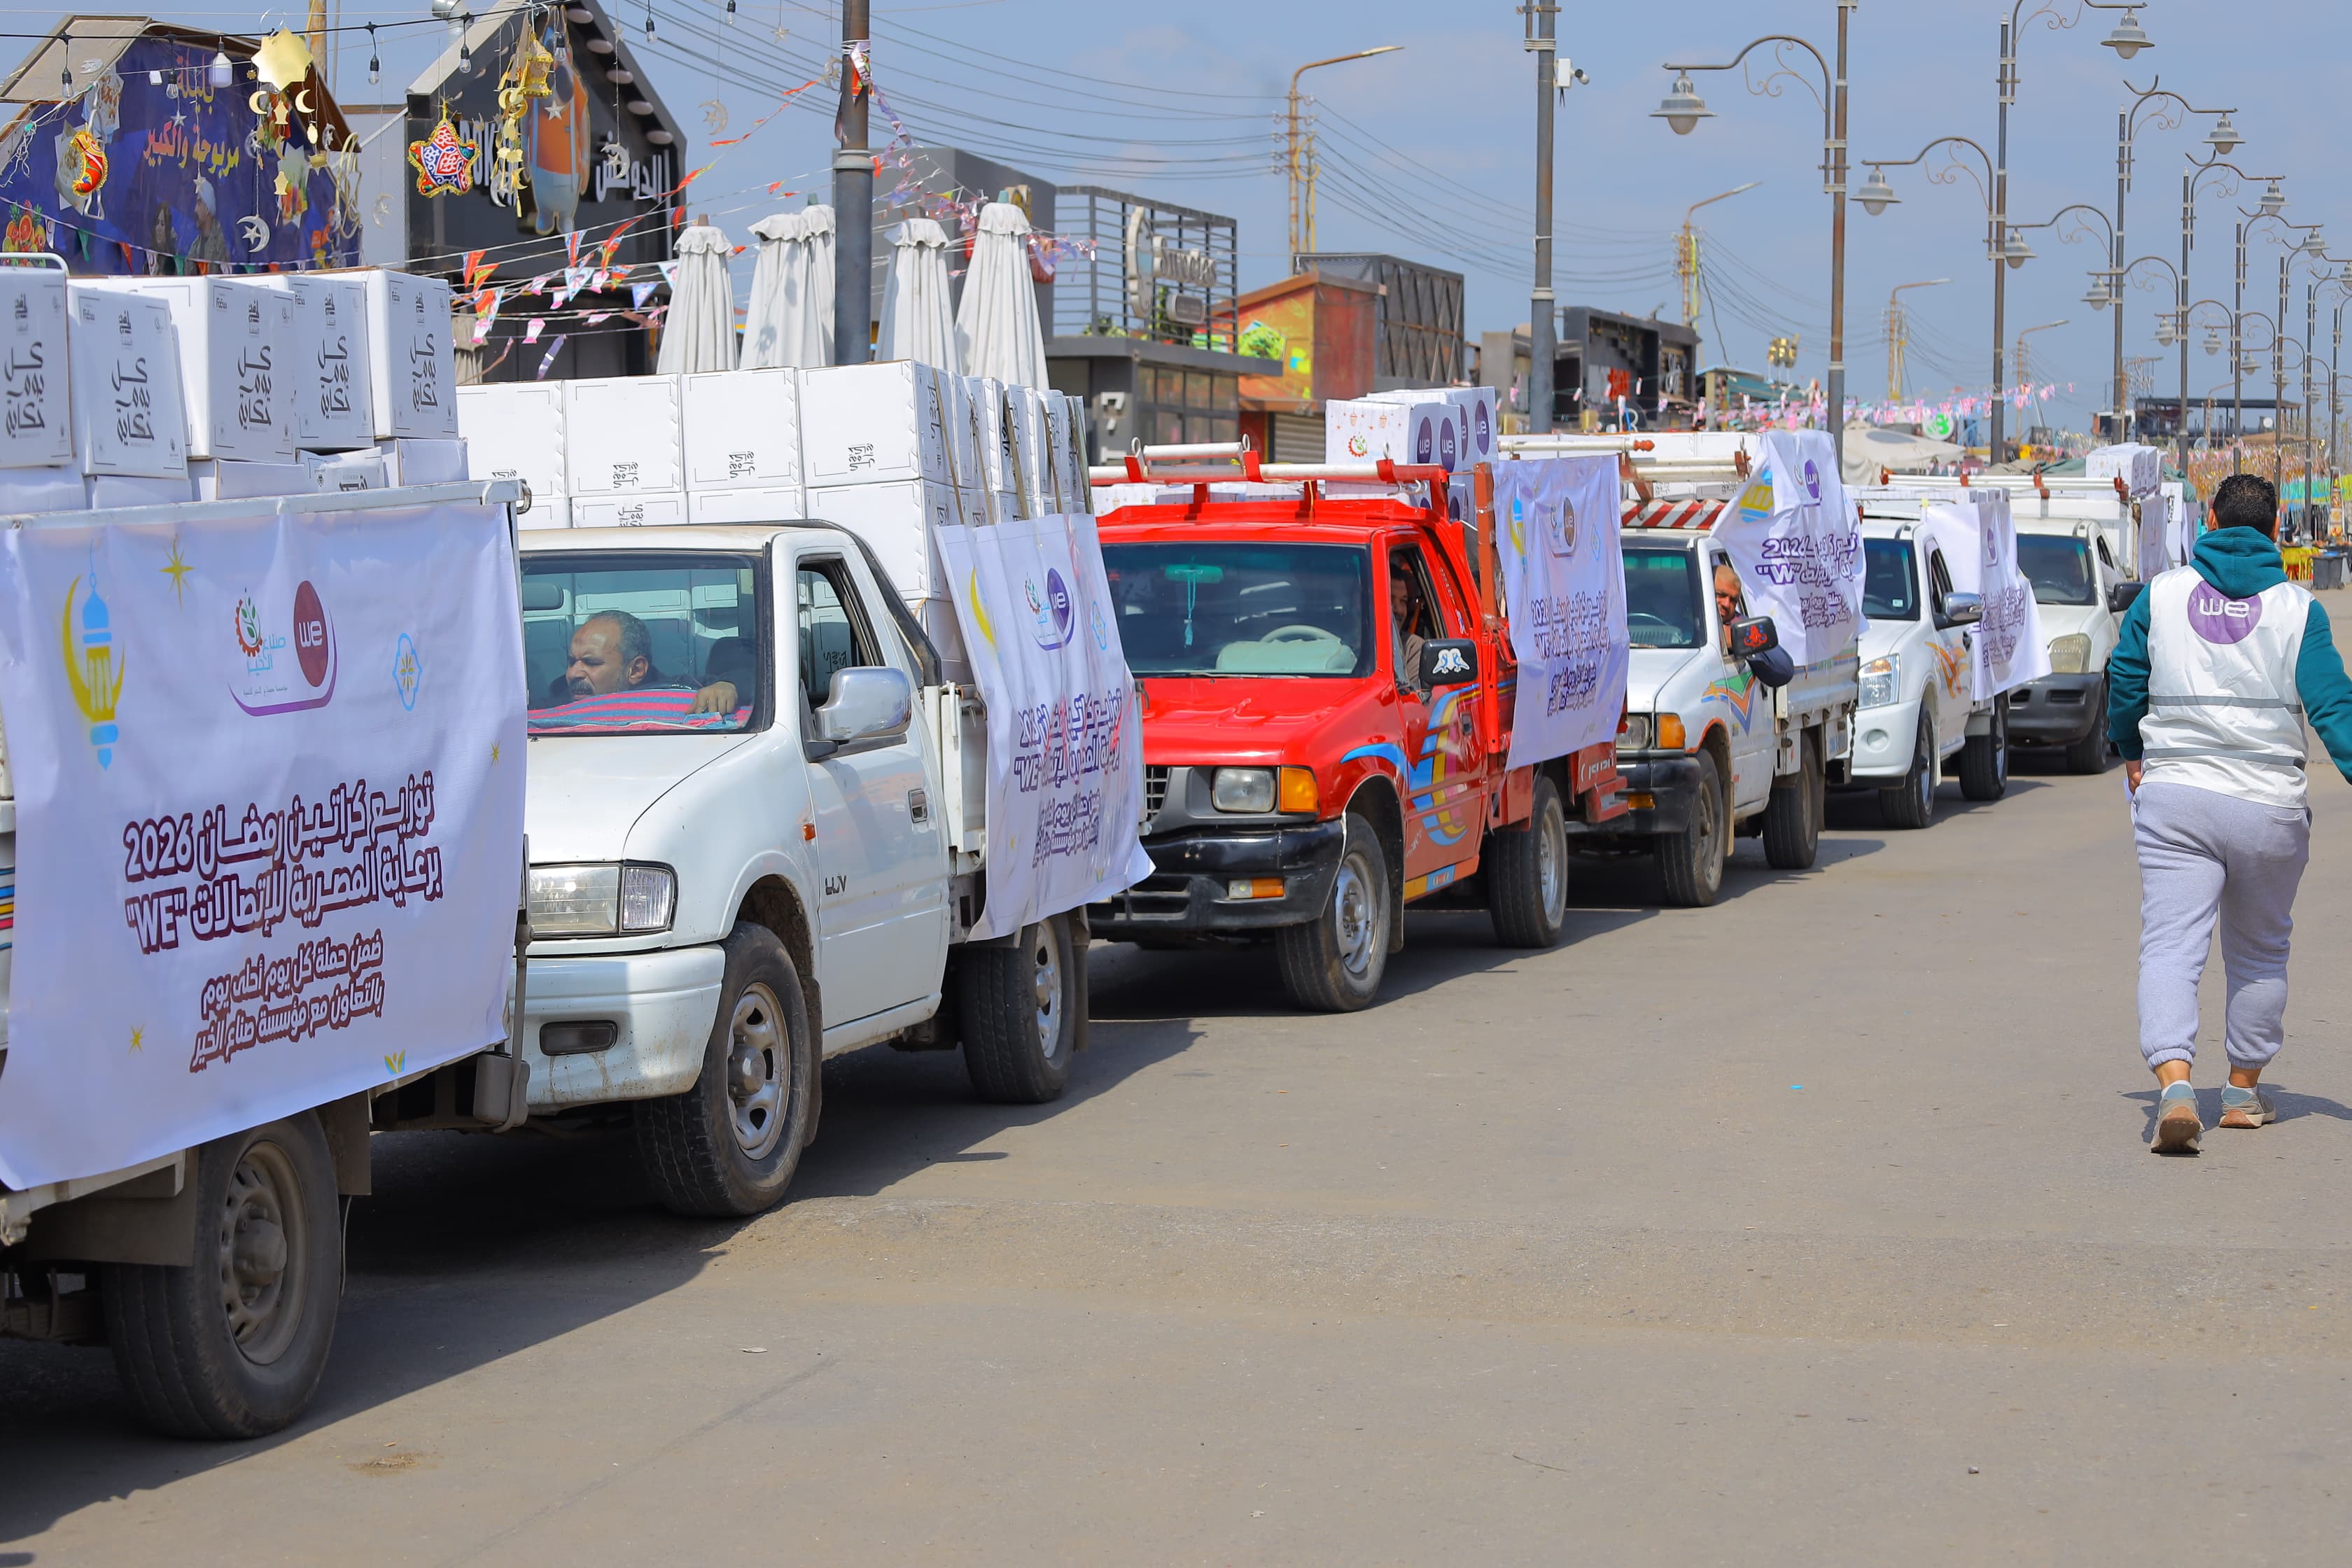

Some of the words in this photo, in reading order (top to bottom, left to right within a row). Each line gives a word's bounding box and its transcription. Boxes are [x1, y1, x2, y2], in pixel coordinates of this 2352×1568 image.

[1419, 439, 1430, 454] we
[1441, 440, 1454, 454] we
[1476, 421, 1487, 435] we
[2199, 598, 2250, 618] we
[299, 620, 323, 648] we
[287, 778, 368, 862] كراتين
[370, 770, 435, 846] توزيع
[123, 813, 194, 882] 2026
[197, 803, 284, 881] رمضان
[290, 846, 379, 928] المصرية
[381, 840, 443, 908] برعاية
[125, 887, 187, 954] "WE"
[293, 941, 314, 993] كل
[314, 937, 349, 979] حملة
[349, 928, 384, 979] ضمن
[201, 974, 231, 1020] يوم
[263, 957, 292, 1002] يوم
[330, 971, 385, 1030] بالتعاون
[224, 1009, 256, 1063] صناع
[257, 995, 308, 1042] مؤسسة
[308, 995, 330, 1038] مع
[190, 1015, 227, 1073] الخير
